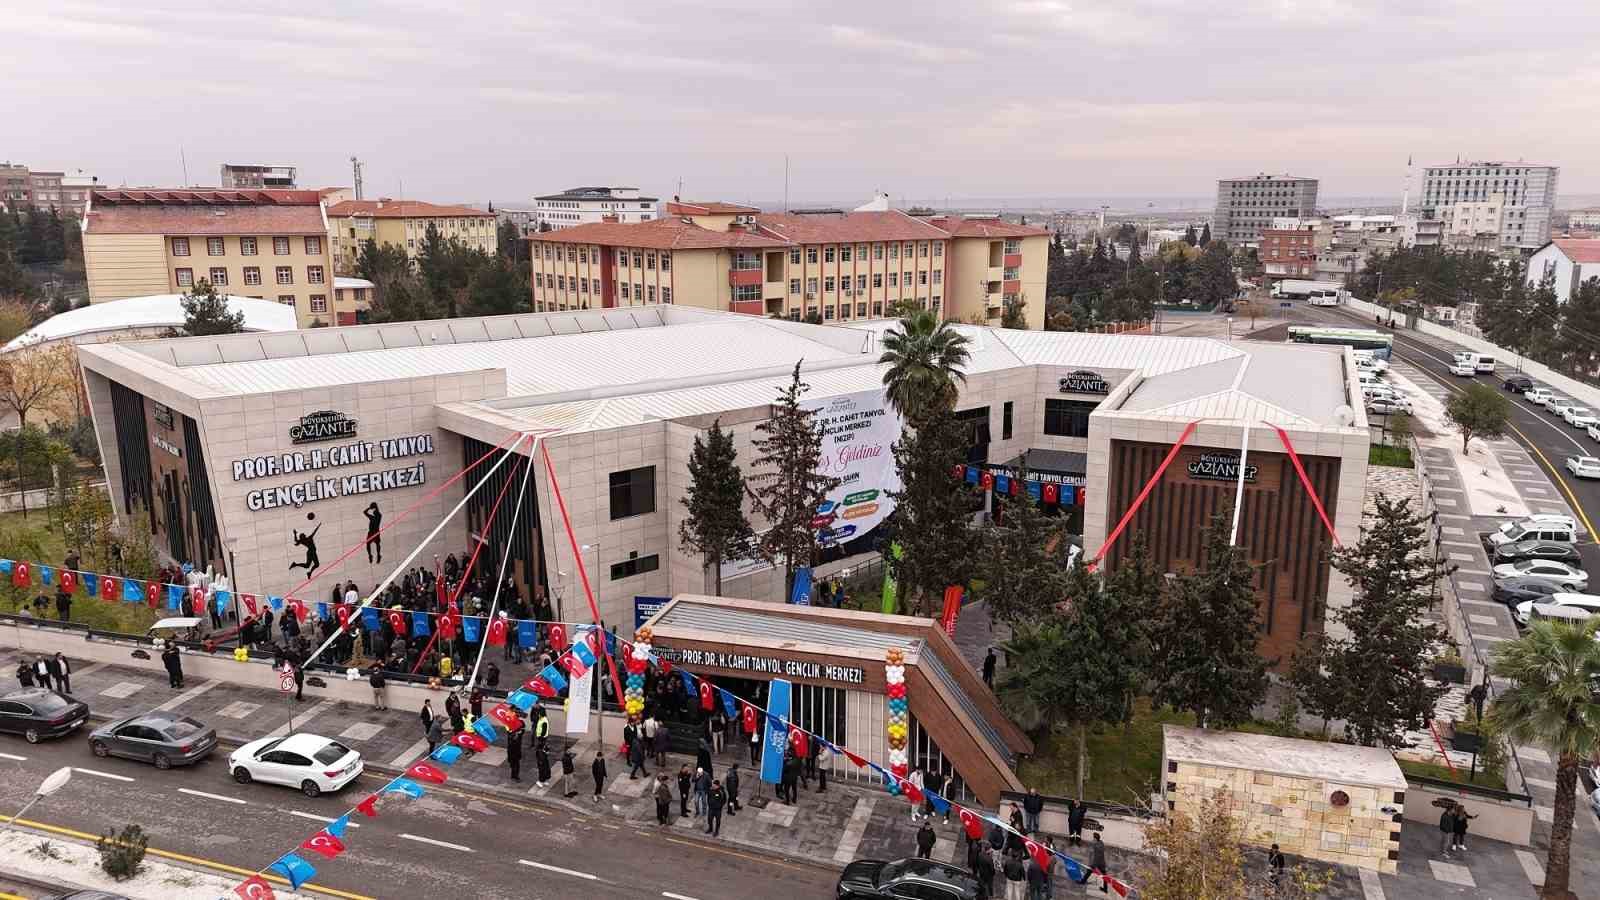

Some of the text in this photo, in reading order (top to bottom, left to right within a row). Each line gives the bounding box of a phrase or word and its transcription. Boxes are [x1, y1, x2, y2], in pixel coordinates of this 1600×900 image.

[232, 435, 433, 481] PROF. DR. H. CAHİT TANYOL
[247, 461, 425, 512] GENÇLİK MERKEZİ
[682, 649, 704, 665] PROF.
[705, 652, 718, 667] DR.
[719, 653, 727, 667] H.
[751, 657, 782, 673] TANYOL
